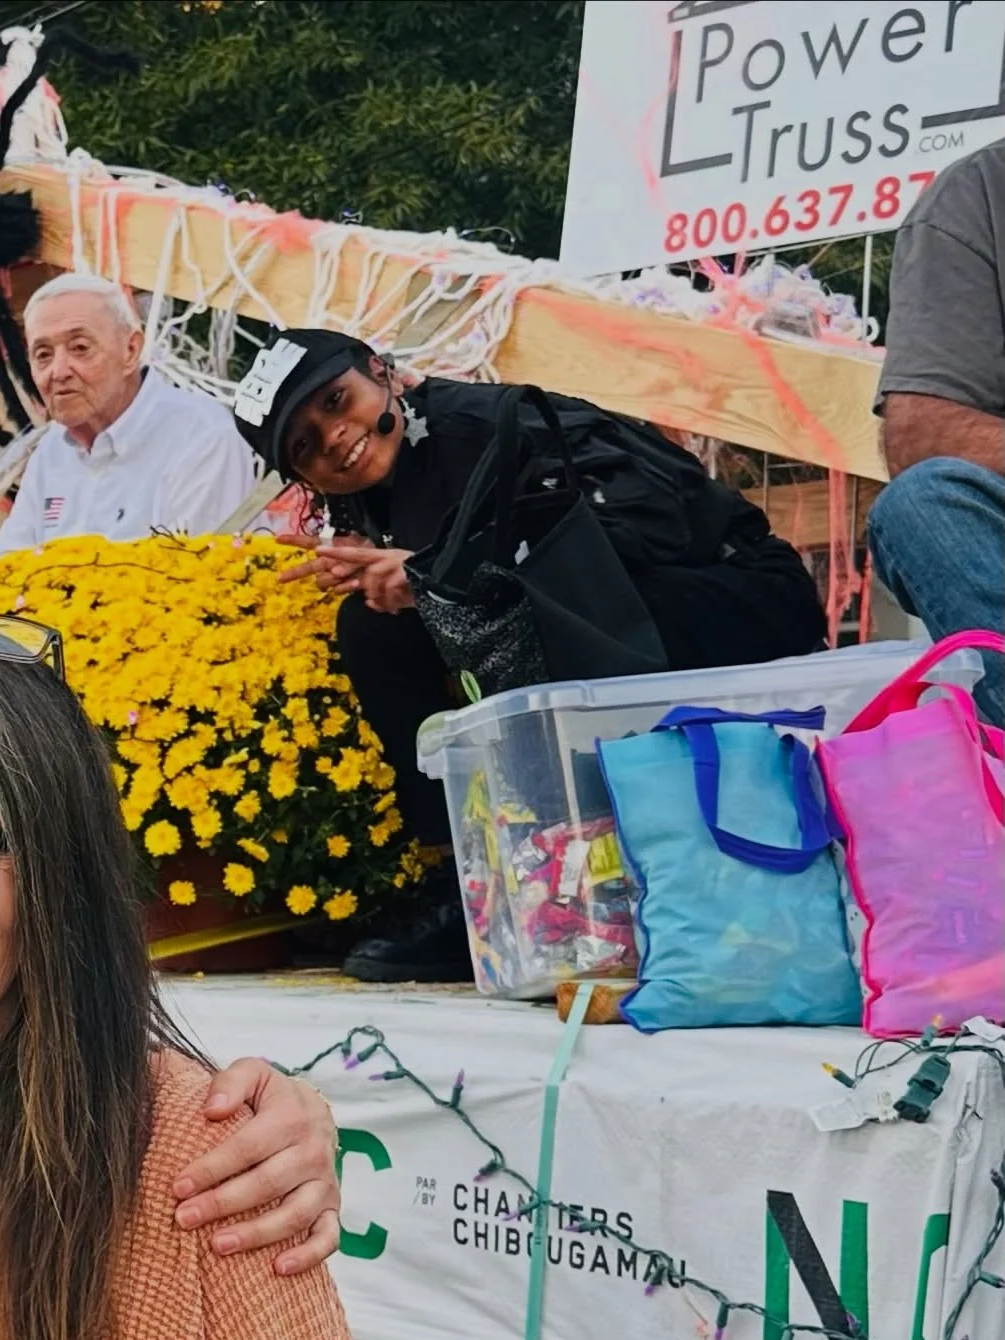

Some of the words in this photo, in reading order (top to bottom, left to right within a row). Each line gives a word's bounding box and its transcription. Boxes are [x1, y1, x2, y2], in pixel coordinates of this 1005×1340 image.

[695, 0, 972, 103] Power
[732, 100, 911, 183] Truss
[415, 1176, 436, 1192] PAR
[453, 1183, 634, 1241] CHANIERS
